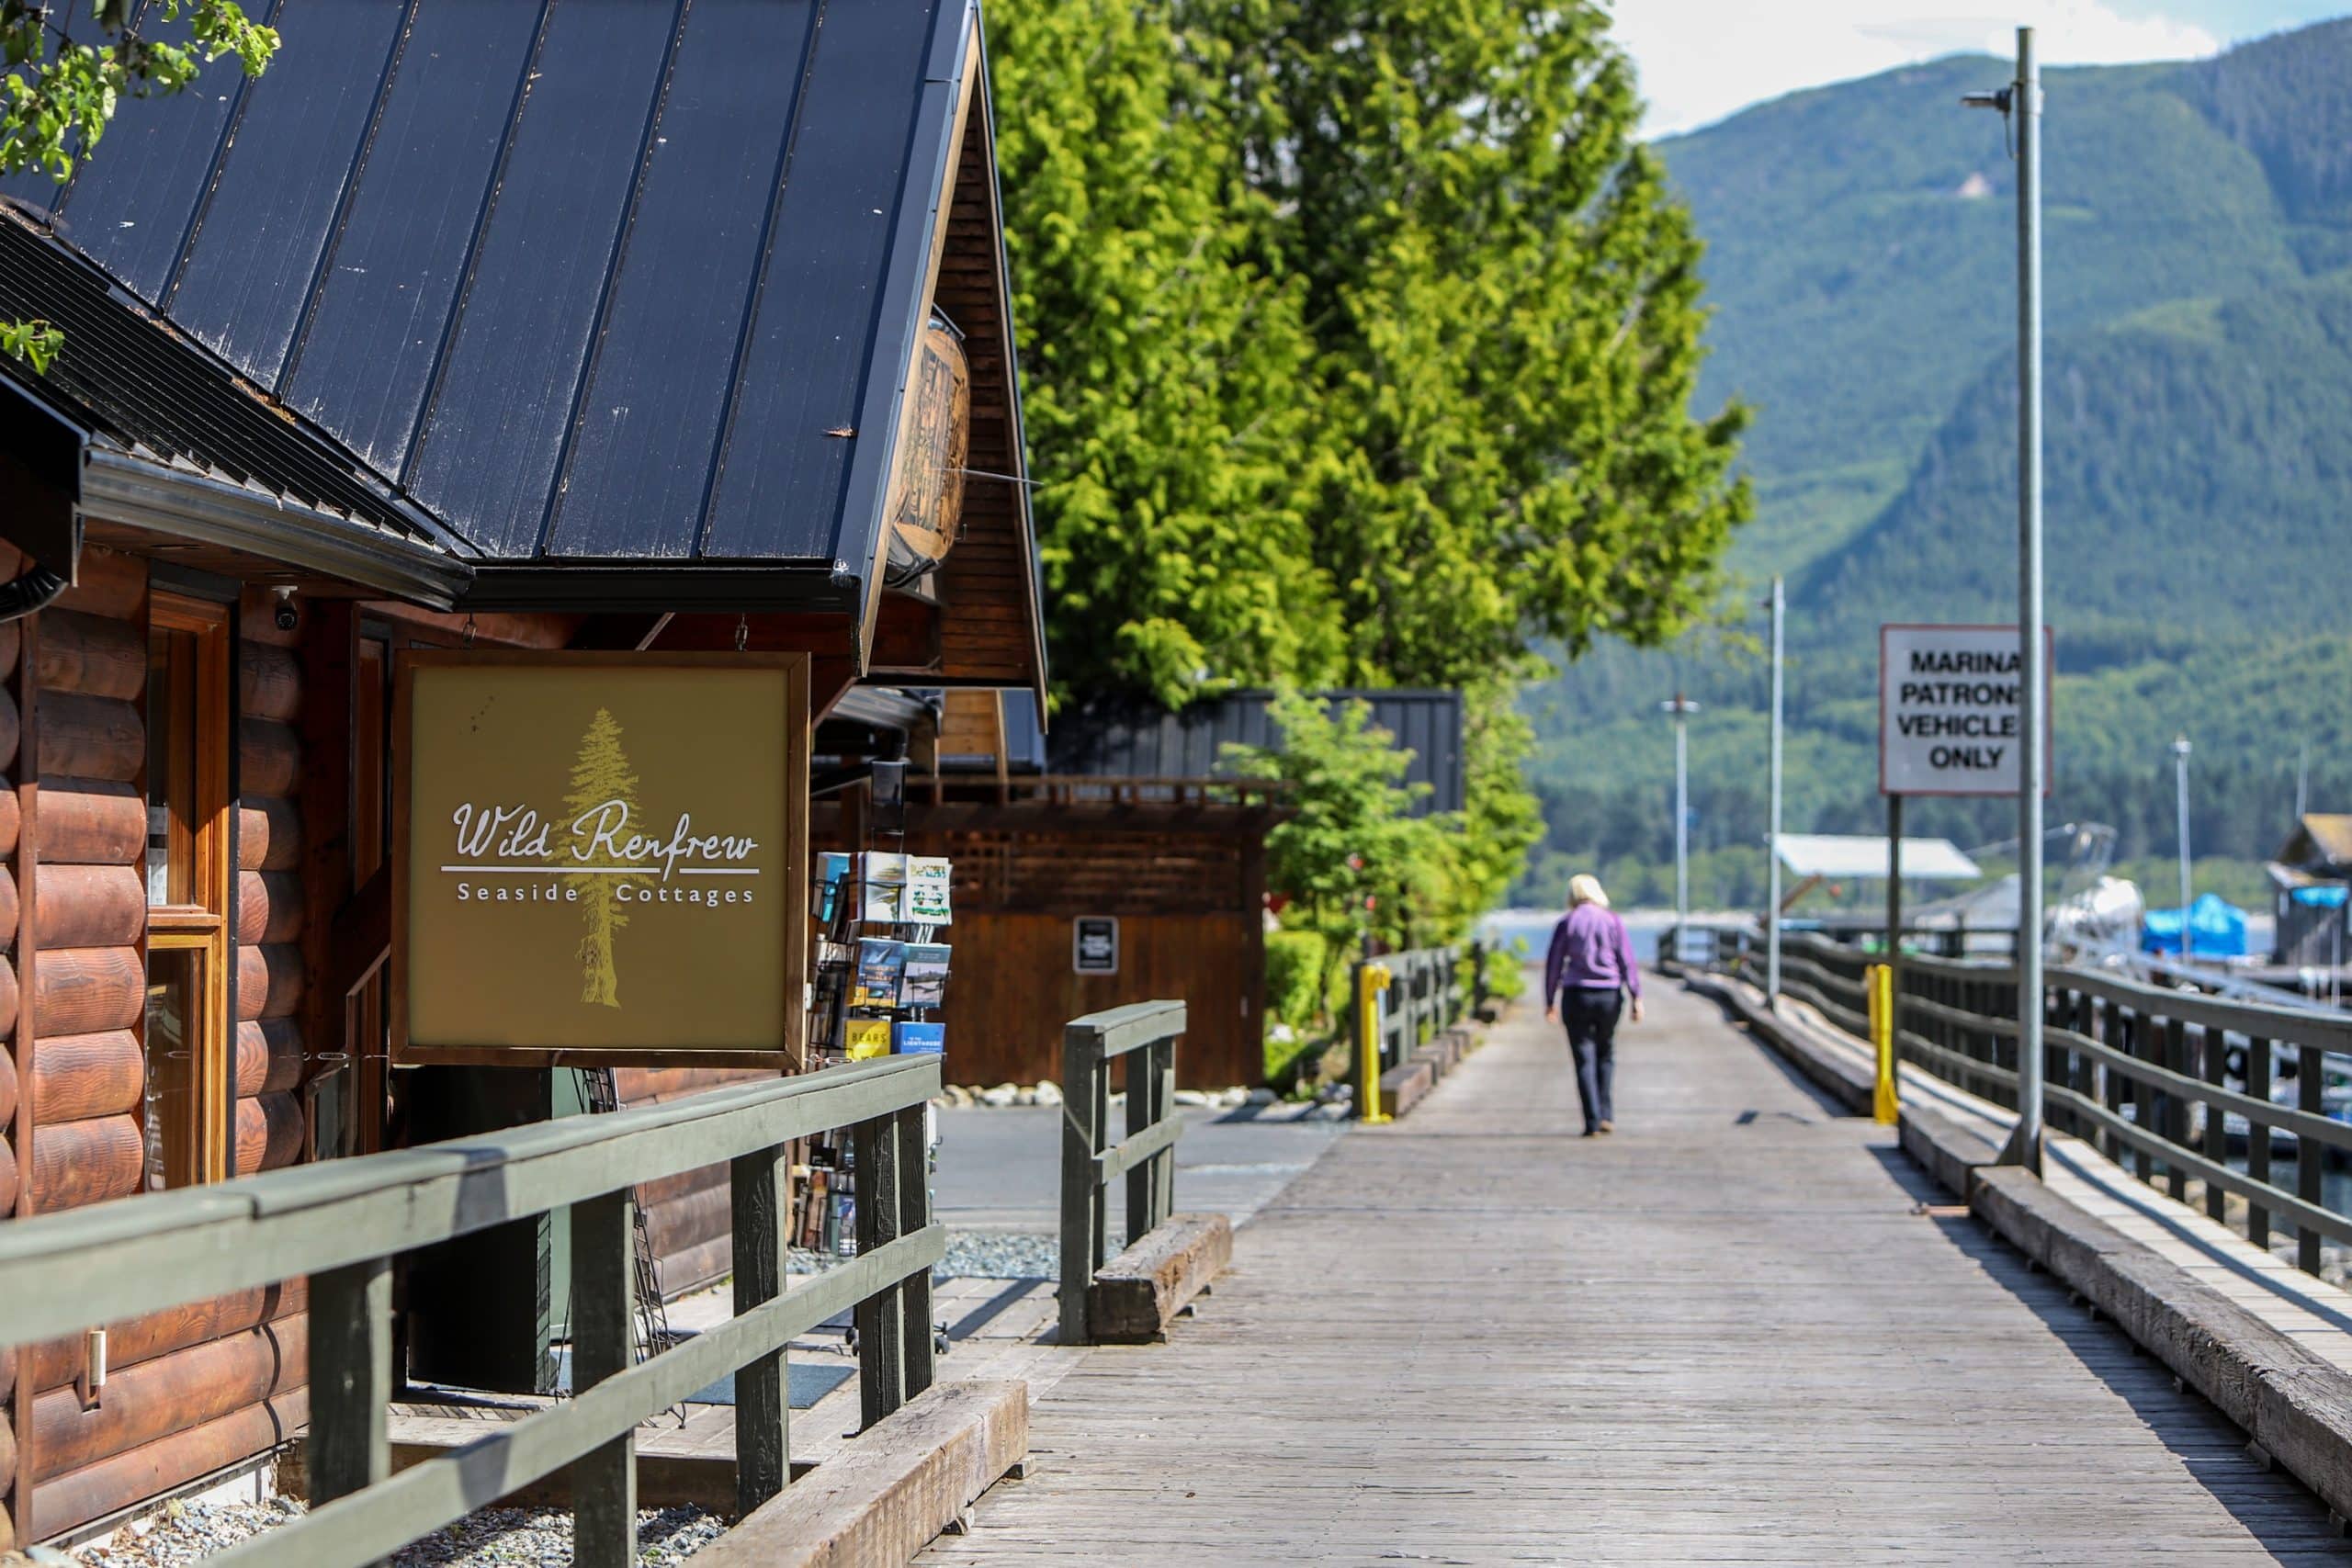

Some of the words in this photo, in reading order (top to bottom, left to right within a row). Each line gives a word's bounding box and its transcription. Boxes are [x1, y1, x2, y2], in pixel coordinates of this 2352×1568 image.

[1910, 650, 2021, 673] MARINA
[1928, 745, 2005, 770] ONLY
[453, 802, 553, 858] Wild
[571, 799, 758, 882] Renfrew
[457, 883, 579, 901] Seaside
[616, 885, 753, 908] Cottages
[852, 1032, 888, 1043] BEARS
